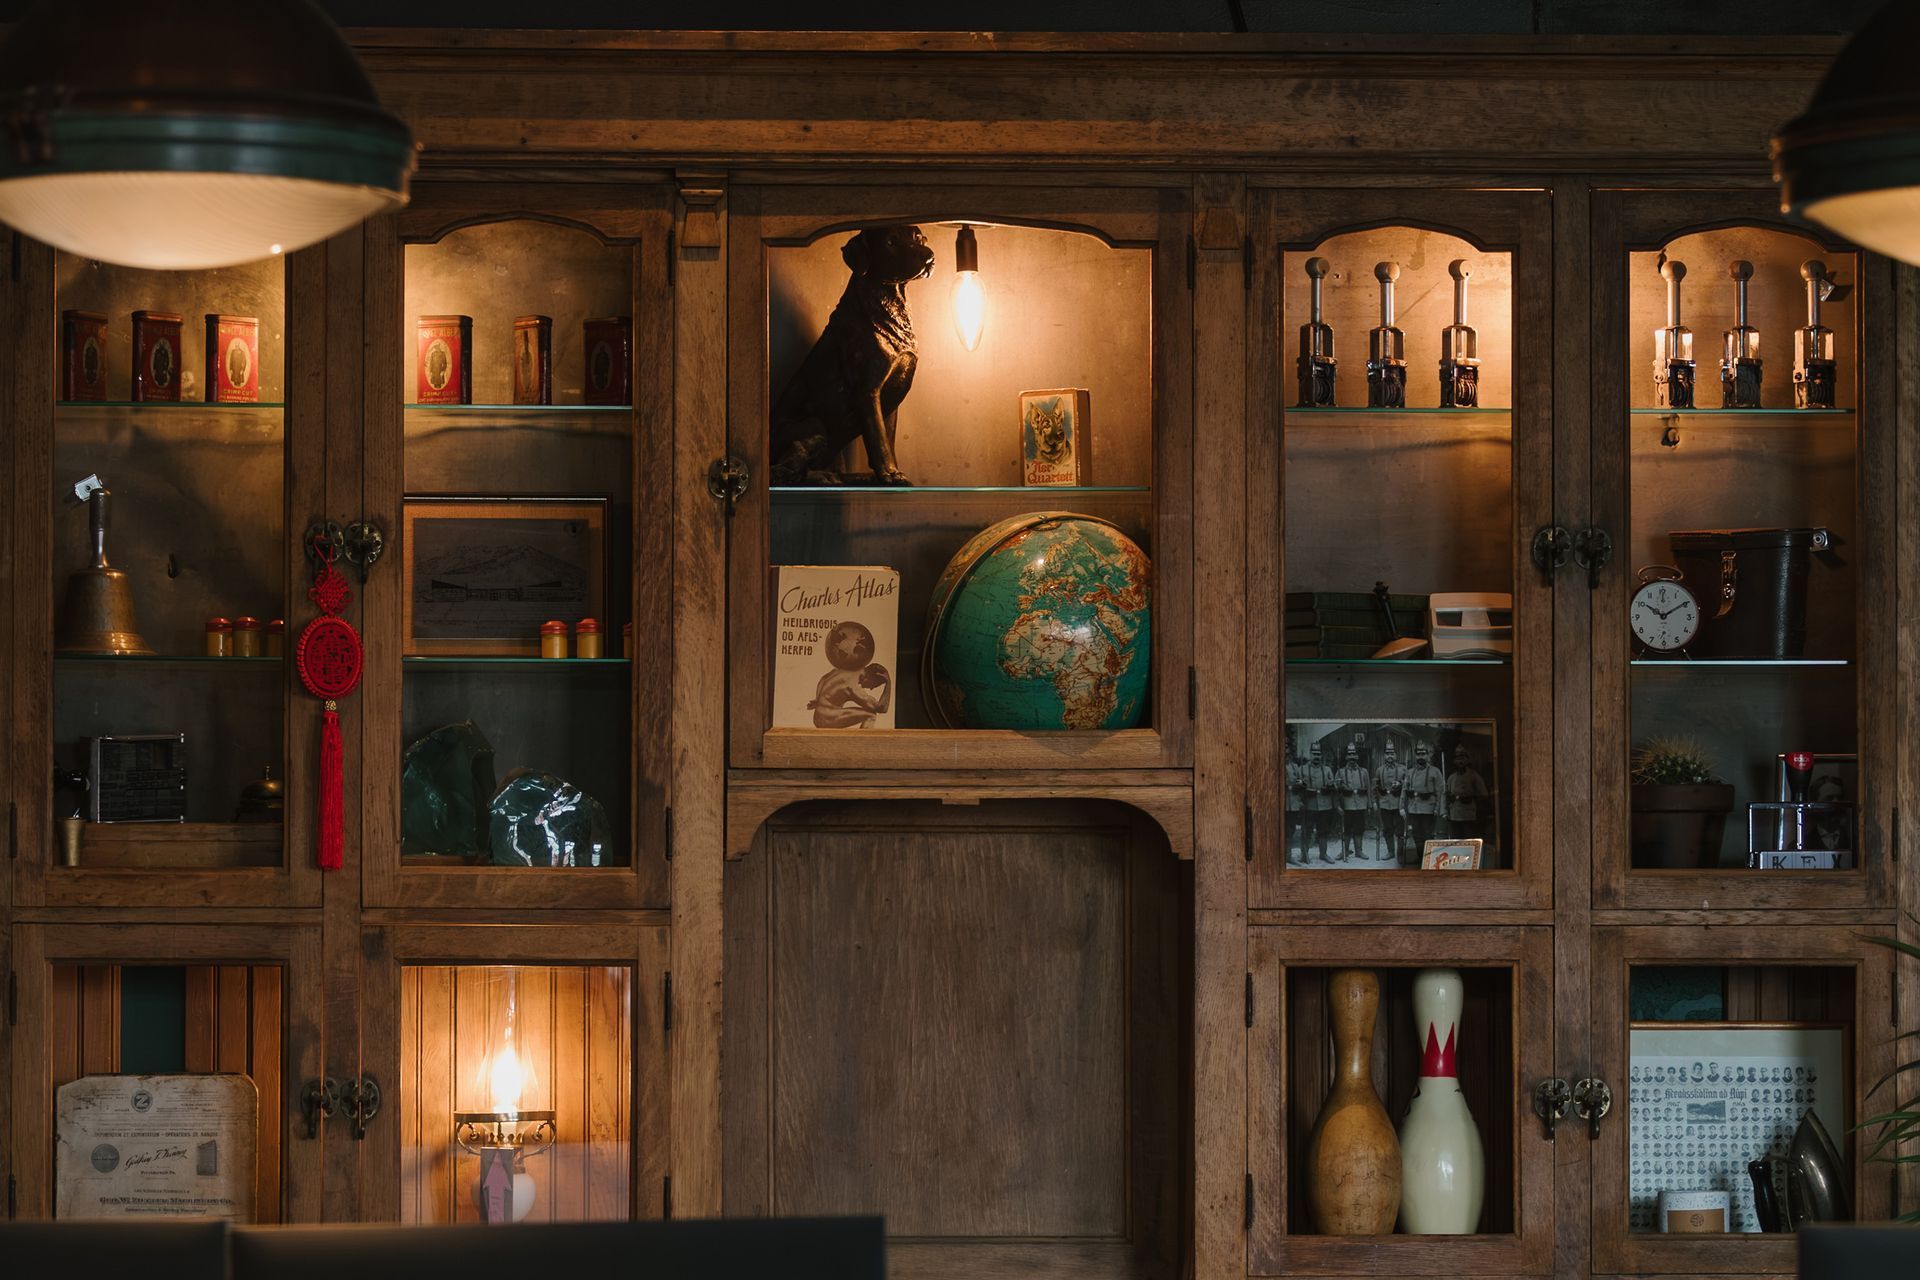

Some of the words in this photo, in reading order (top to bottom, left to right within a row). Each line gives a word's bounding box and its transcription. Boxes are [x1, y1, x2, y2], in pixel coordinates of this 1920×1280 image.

[780, 586, 842, 614] Charles
[845, 574, 897, 608] Atlas
[782, 631, 794, 642] OG
[797, 632, 822, 642] AFLS-
